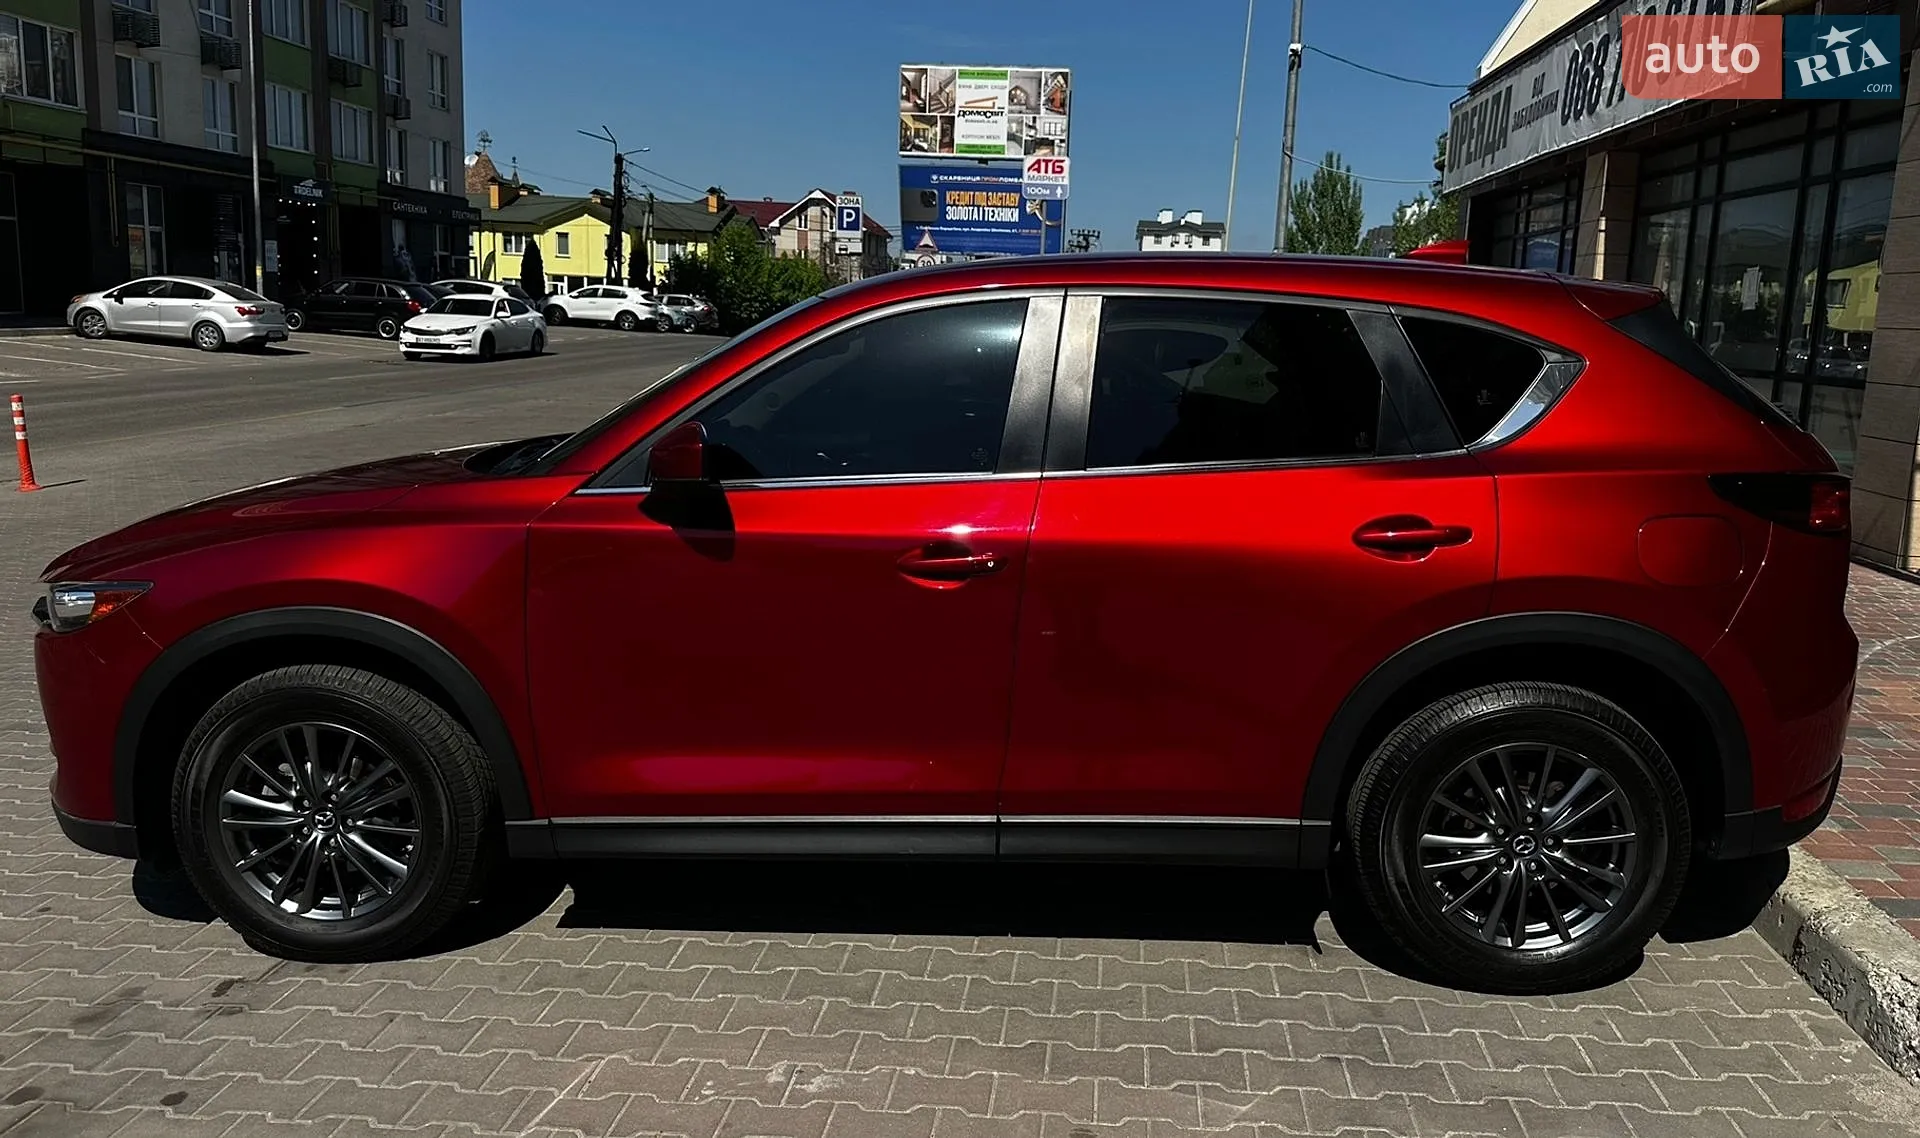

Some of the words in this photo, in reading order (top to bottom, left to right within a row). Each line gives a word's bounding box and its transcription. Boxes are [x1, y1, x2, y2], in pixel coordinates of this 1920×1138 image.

[1027, 158, 1066, 174] АТБ
[838, 197, 860, 205] ЗОНА
[945, 190, 974, 206] КРЕДИТ
[974, 191, 987, 207] ПІД
[987, 192, 1020, 207] ЗАСТАВУ
[945, 205, 979, 221] ЗОЛОТА
[983, 206, 1019, 222] ТЕХНІКИ
